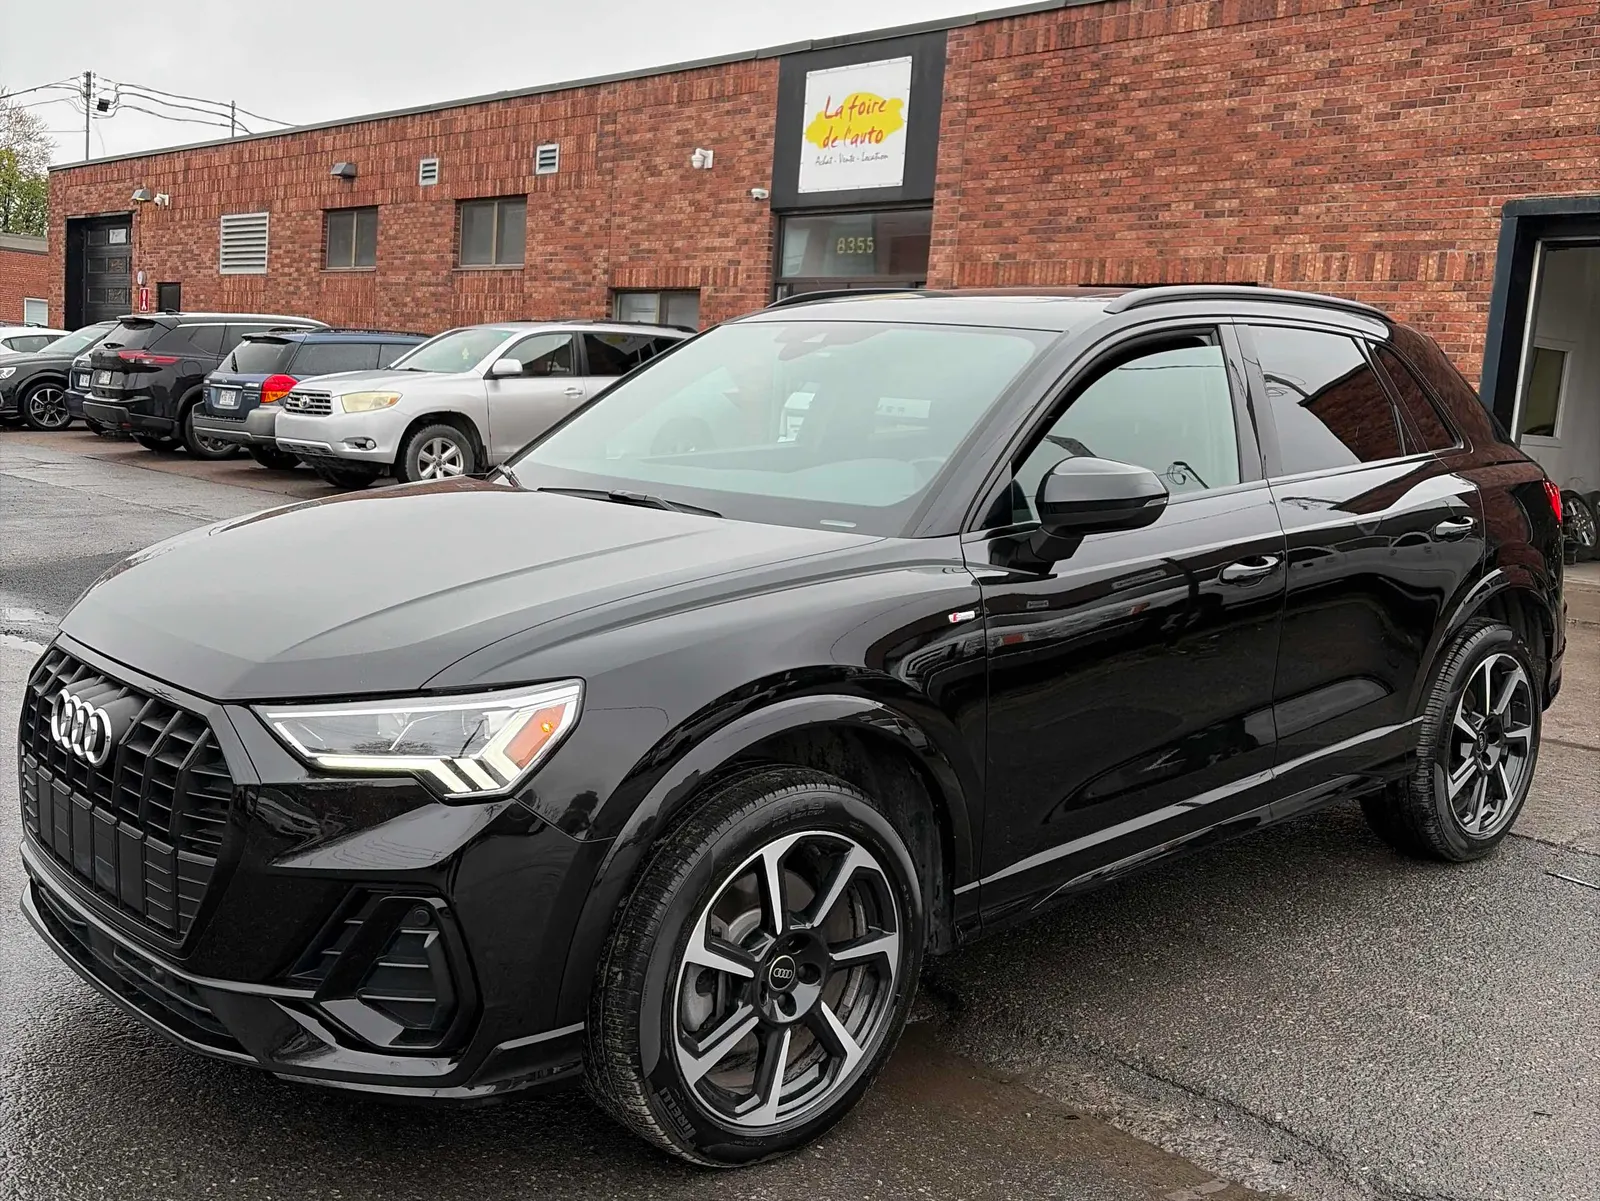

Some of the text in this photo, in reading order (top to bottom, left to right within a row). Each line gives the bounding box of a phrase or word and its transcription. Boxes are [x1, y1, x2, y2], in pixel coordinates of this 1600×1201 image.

[824, 95, 887, 122] La foire
[822, 126, 884, 149] de l'auto
[815, 151, 889, 166] Achat Vente Location
[837, 236, 874, 254] 8355
[653, 1087, 697, 1141] PIRELLI
